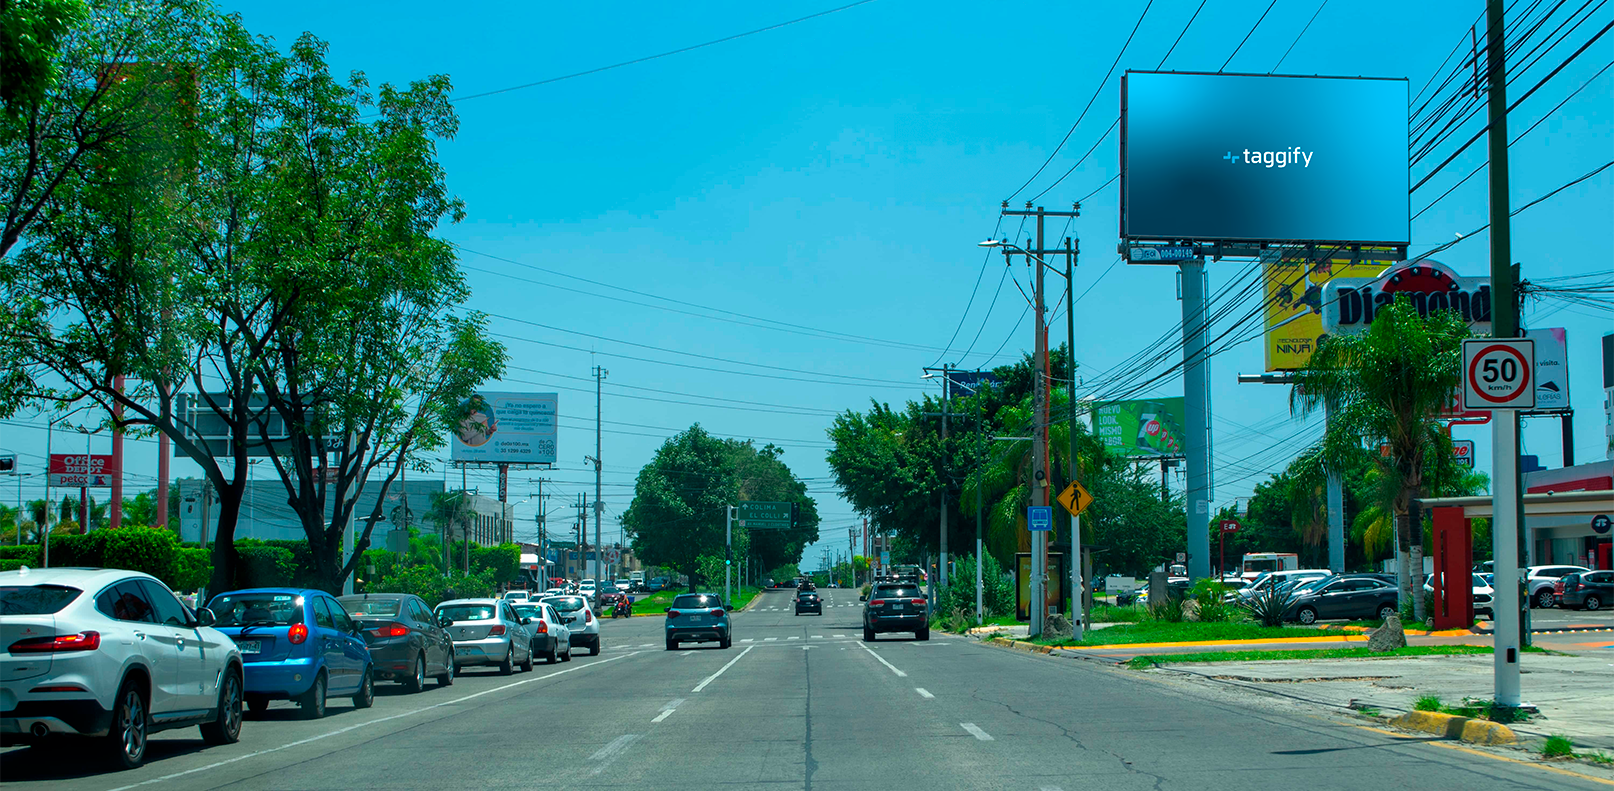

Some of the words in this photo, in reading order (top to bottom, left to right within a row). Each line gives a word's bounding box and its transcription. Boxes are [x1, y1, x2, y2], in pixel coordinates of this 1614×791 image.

[1242, 146, 1314, 168] taggify
[1337, 285, 1492, 326] Diamond
[1482, 358, 1517, 383] 50
[1539, 359, 1560, 367] visita.
[1098, 426, 1122, 436] MISMO
